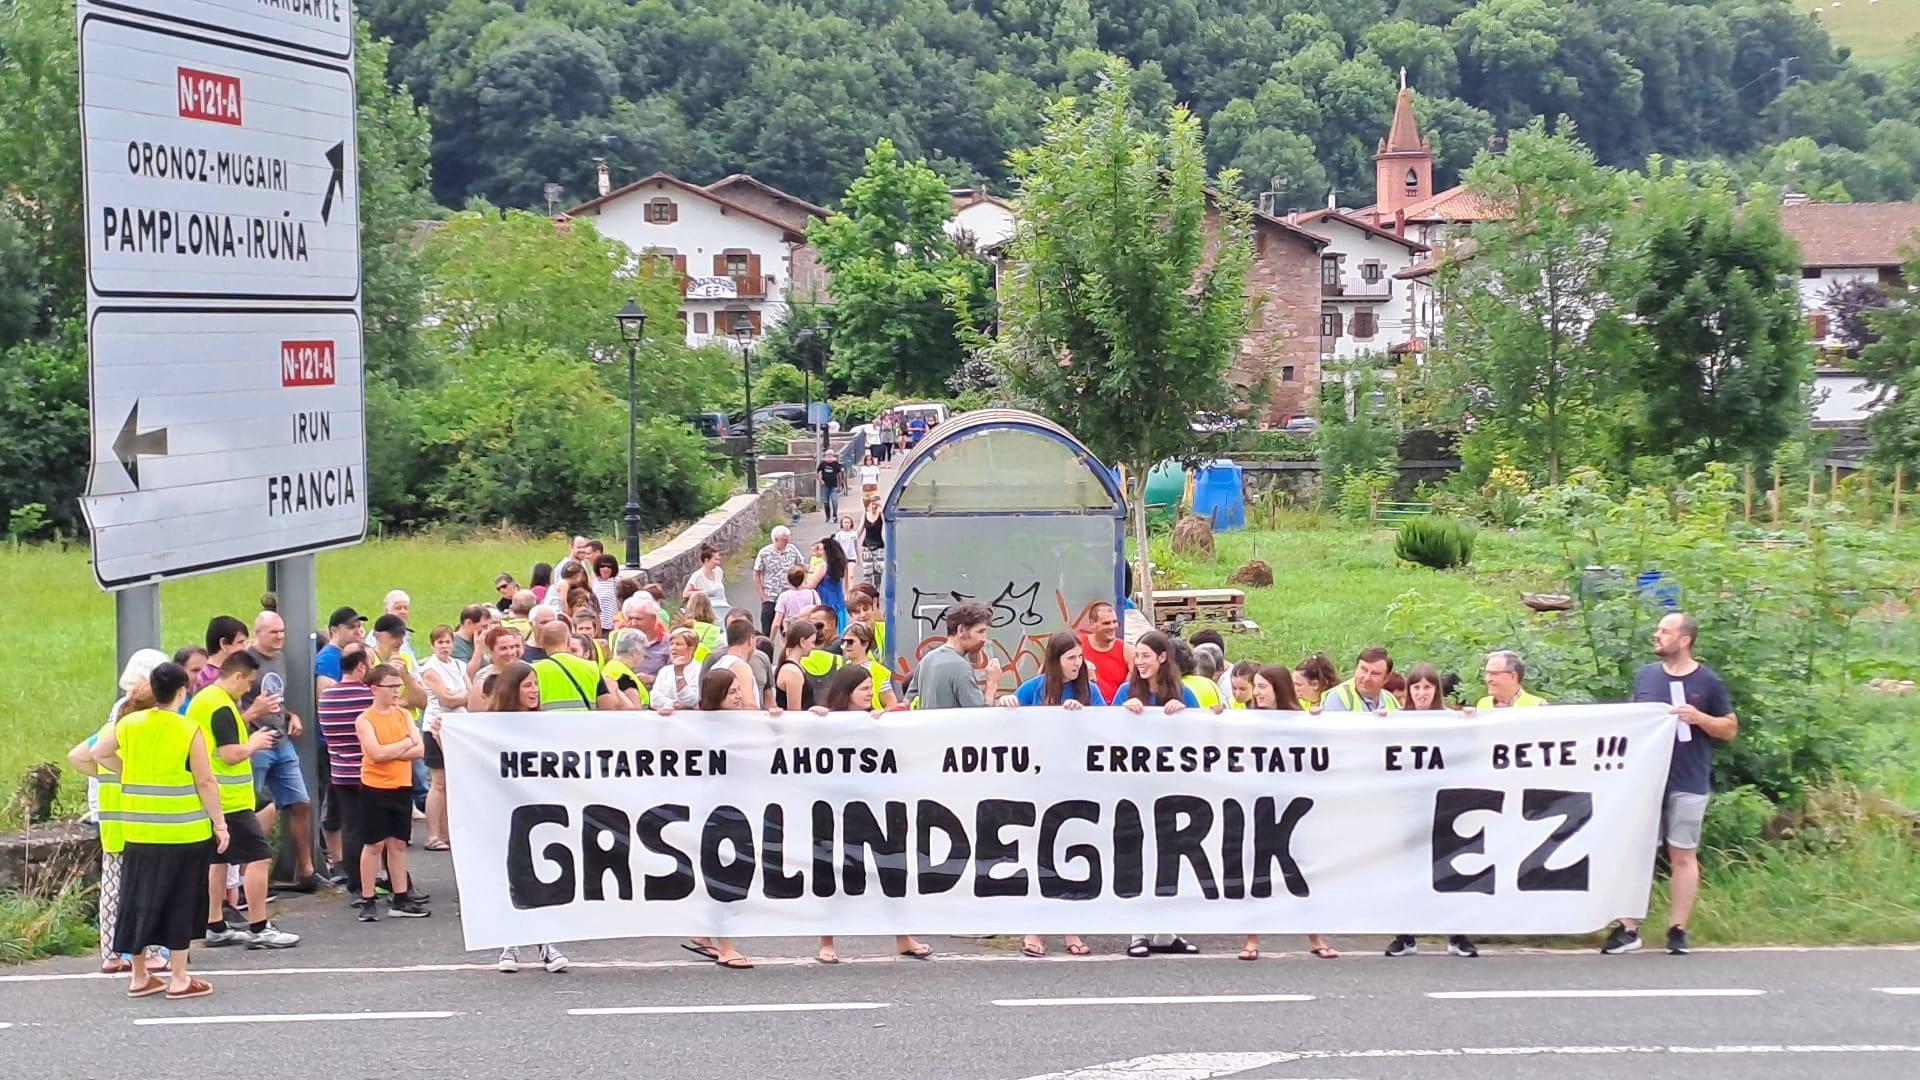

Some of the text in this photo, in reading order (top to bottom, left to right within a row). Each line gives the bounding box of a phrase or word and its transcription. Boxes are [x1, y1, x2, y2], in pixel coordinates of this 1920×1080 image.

[180, 75, 240, 119] N-121-A
[128, 141, 288, 191] ORONOZ-MUGAIRI
[283, 347, 333, 380] N-121-A
[293, 411, 331, 444] IRUN
[268, 466, 355, 517] FRANCIA
[500, 749, 728, 779] HERRITARREN
[770, 747, 898, 775] AHOTSA
[942, 746, 1042, 775] ADITU,
[1086, 745, 1330, 773] ERRESPETATU
[1385, 745, 1445, 771] ETA
[506, 788, 1593, 910] GASOLINDEGIRIK EZ
